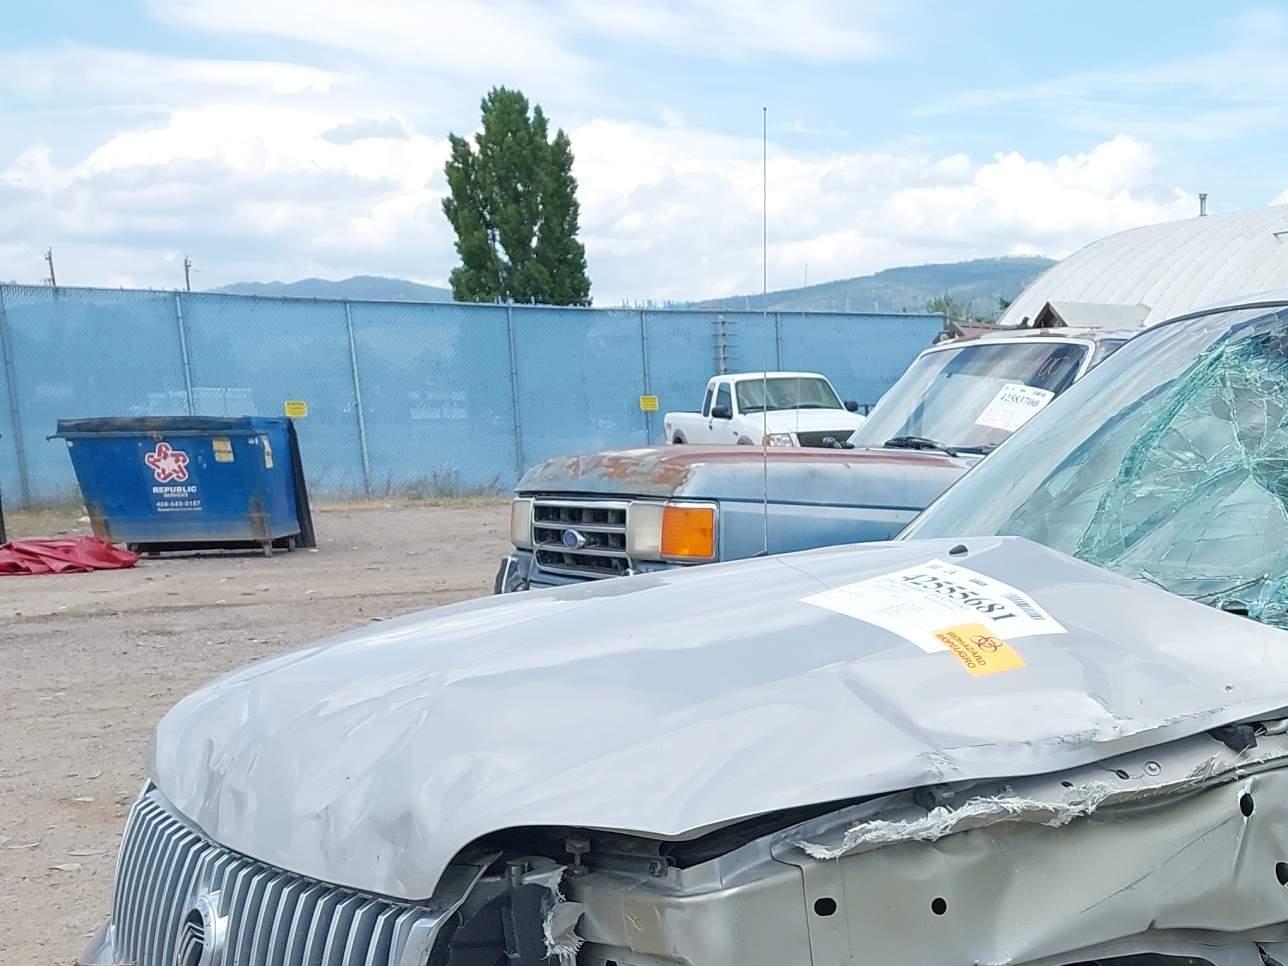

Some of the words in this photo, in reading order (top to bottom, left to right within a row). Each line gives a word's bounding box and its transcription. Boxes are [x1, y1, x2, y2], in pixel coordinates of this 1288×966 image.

[153, 486, 197, 494] REPUBLIC
[902, 573, 1017, 622] 42555681
[935, 633, 977, 670] BIOPELIGRO
[945, 631, 987, 667] BIOHAZARD
